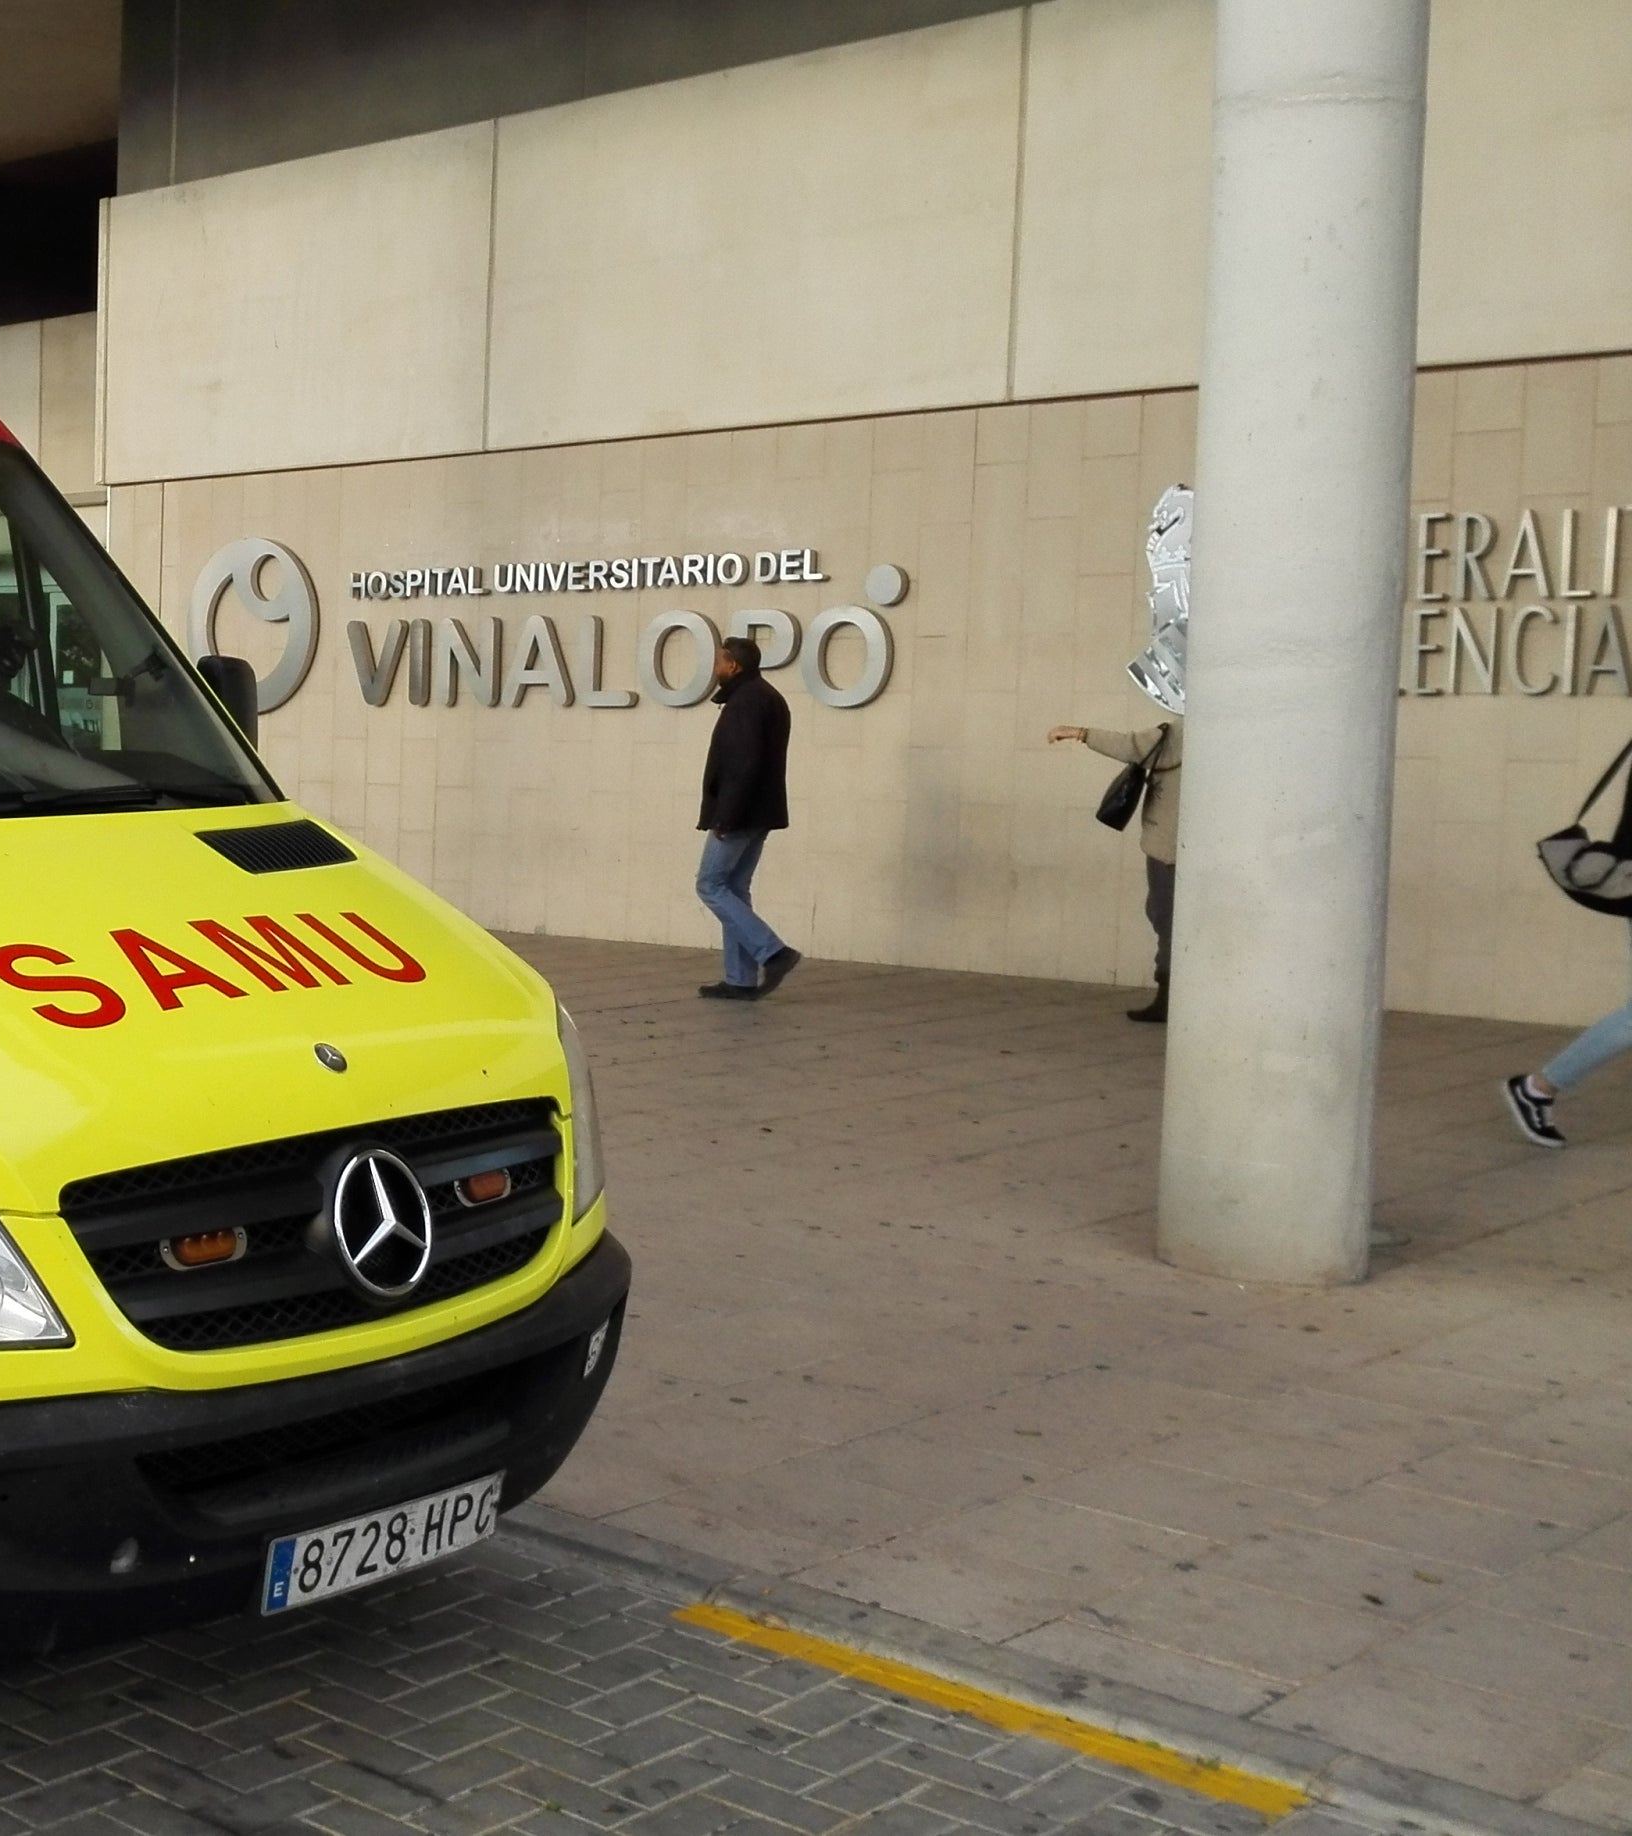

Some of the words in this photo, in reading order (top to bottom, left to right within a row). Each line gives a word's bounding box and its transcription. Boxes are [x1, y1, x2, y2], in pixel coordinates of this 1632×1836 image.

[349, 565, 486, 601] HOSPITAL
[493, 552, 752, 593] UNIVERSITARIO
[754, 548, 831, 583] DEL
[1414, 505, 1632, 601] ERALI
[1396, 603, 1632, 697] ENCIA
[273, 1581, 285, 1598] E
[298, 1511, 409, 1594] 8728
